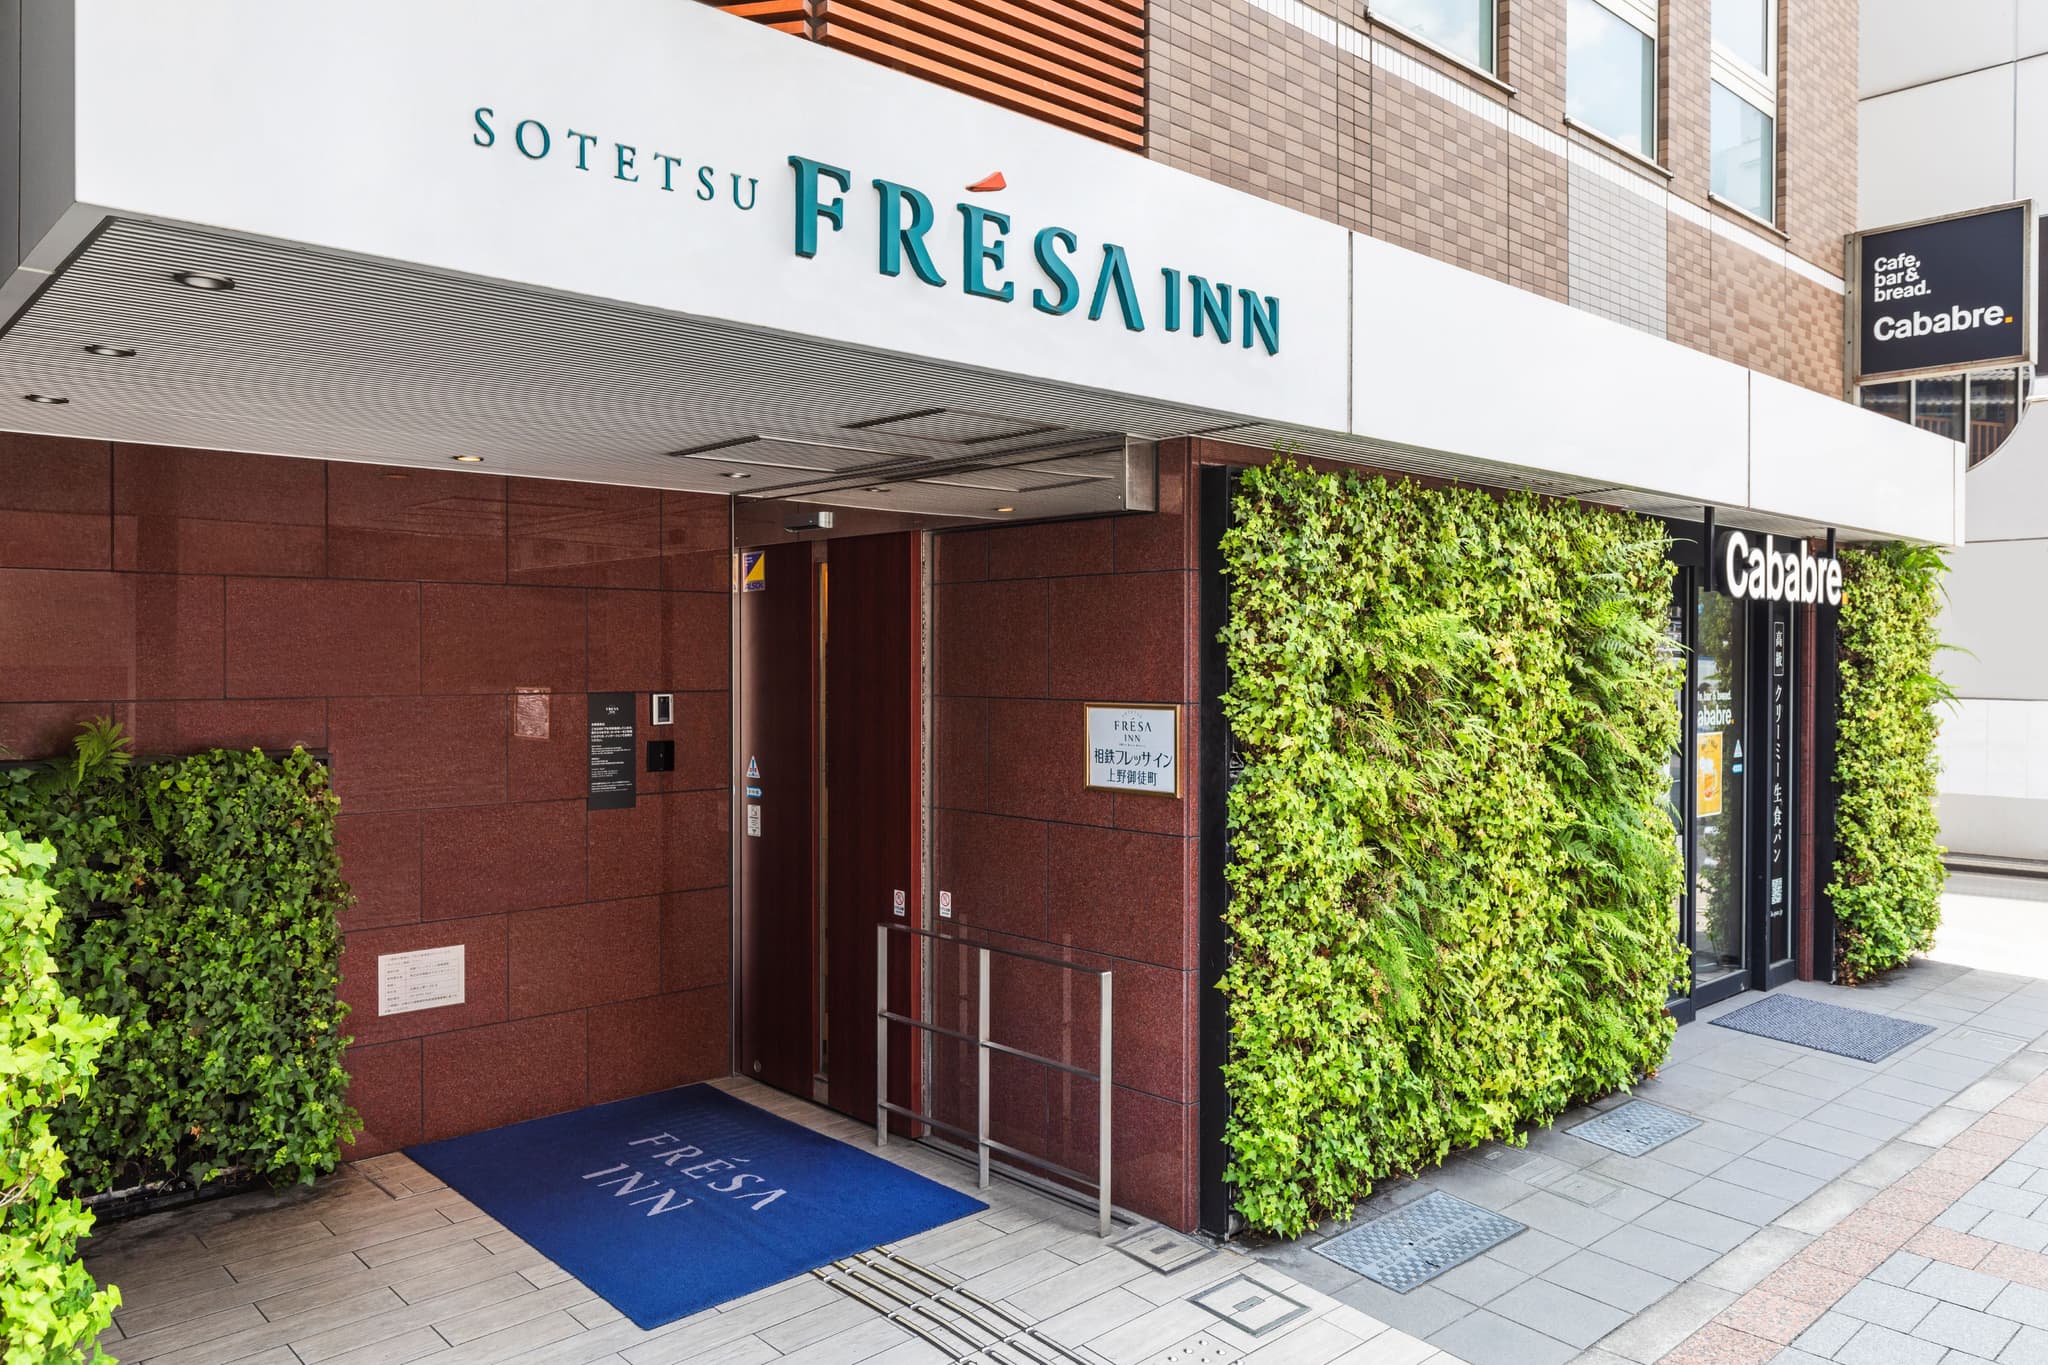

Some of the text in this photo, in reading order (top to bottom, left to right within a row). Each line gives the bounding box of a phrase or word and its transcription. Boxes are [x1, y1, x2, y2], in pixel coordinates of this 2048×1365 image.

[473, 107, 759, 211] SOTETSU
[1161, 267, 1280, 356] INN
[1874, 253, 1921, 272] Cafe,
[1874, 280, 1932, 303] bread.
[1873, 305, 2014, 342] Cababre.
[1697, 705, 1735, 725] ababre.
[1124, 734, 1141, 743] INN
[1094, 748, 1173, 769] 相鉄フレッサイン
[1106, 767, 1158, 787] 上野御徒町
[581, 1162, 694, 1217] INN
